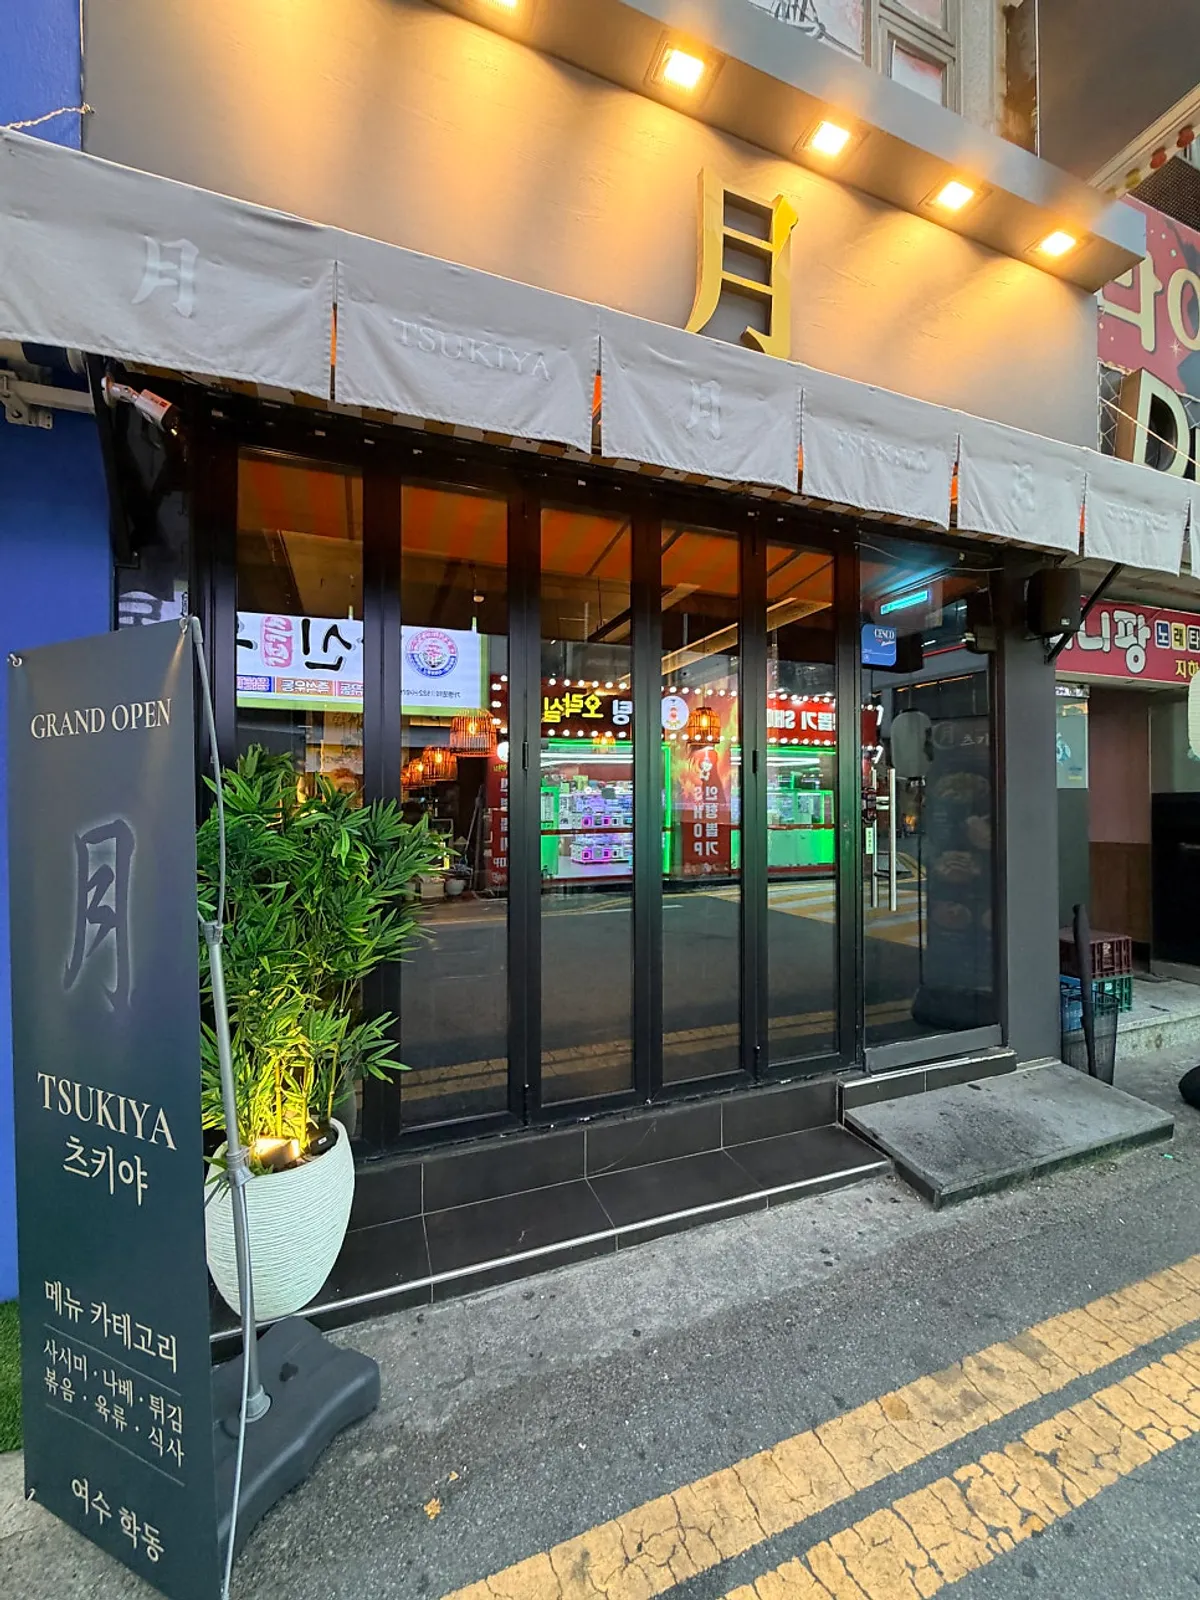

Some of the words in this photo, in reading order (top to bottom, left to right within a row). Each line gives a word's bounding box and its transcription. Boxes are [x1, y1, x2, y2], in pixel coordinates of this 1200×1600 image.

[392, 318, 551, 381] TSUKIYA
[1056, 609, 1151, 674] 니팡
[30, 707, 106, 739] GRAND
[111, 698, 172, 732] OPEN
[37, 1071, 178, 1151] TSUKIYA
[63, 1135, 148, 1206] 츠키야
[44, 1280, 84, 1323] 메뉴
[90, 1302, 177, 1374] 카테고리
[43, 1339, 88, 1381] 사시미
[102, 1368, 134, 1407] 나베
[149, 1394, 184, 1434] 튀김
[44, 1367, 76, 1403] 볶음
[94, 1394, 129, 1430] 육류
[148, 1427, 185, 1468] 식사
[71, 1478, 113, 1525] 여수
[118, 1505, 165, 1563] 학동
